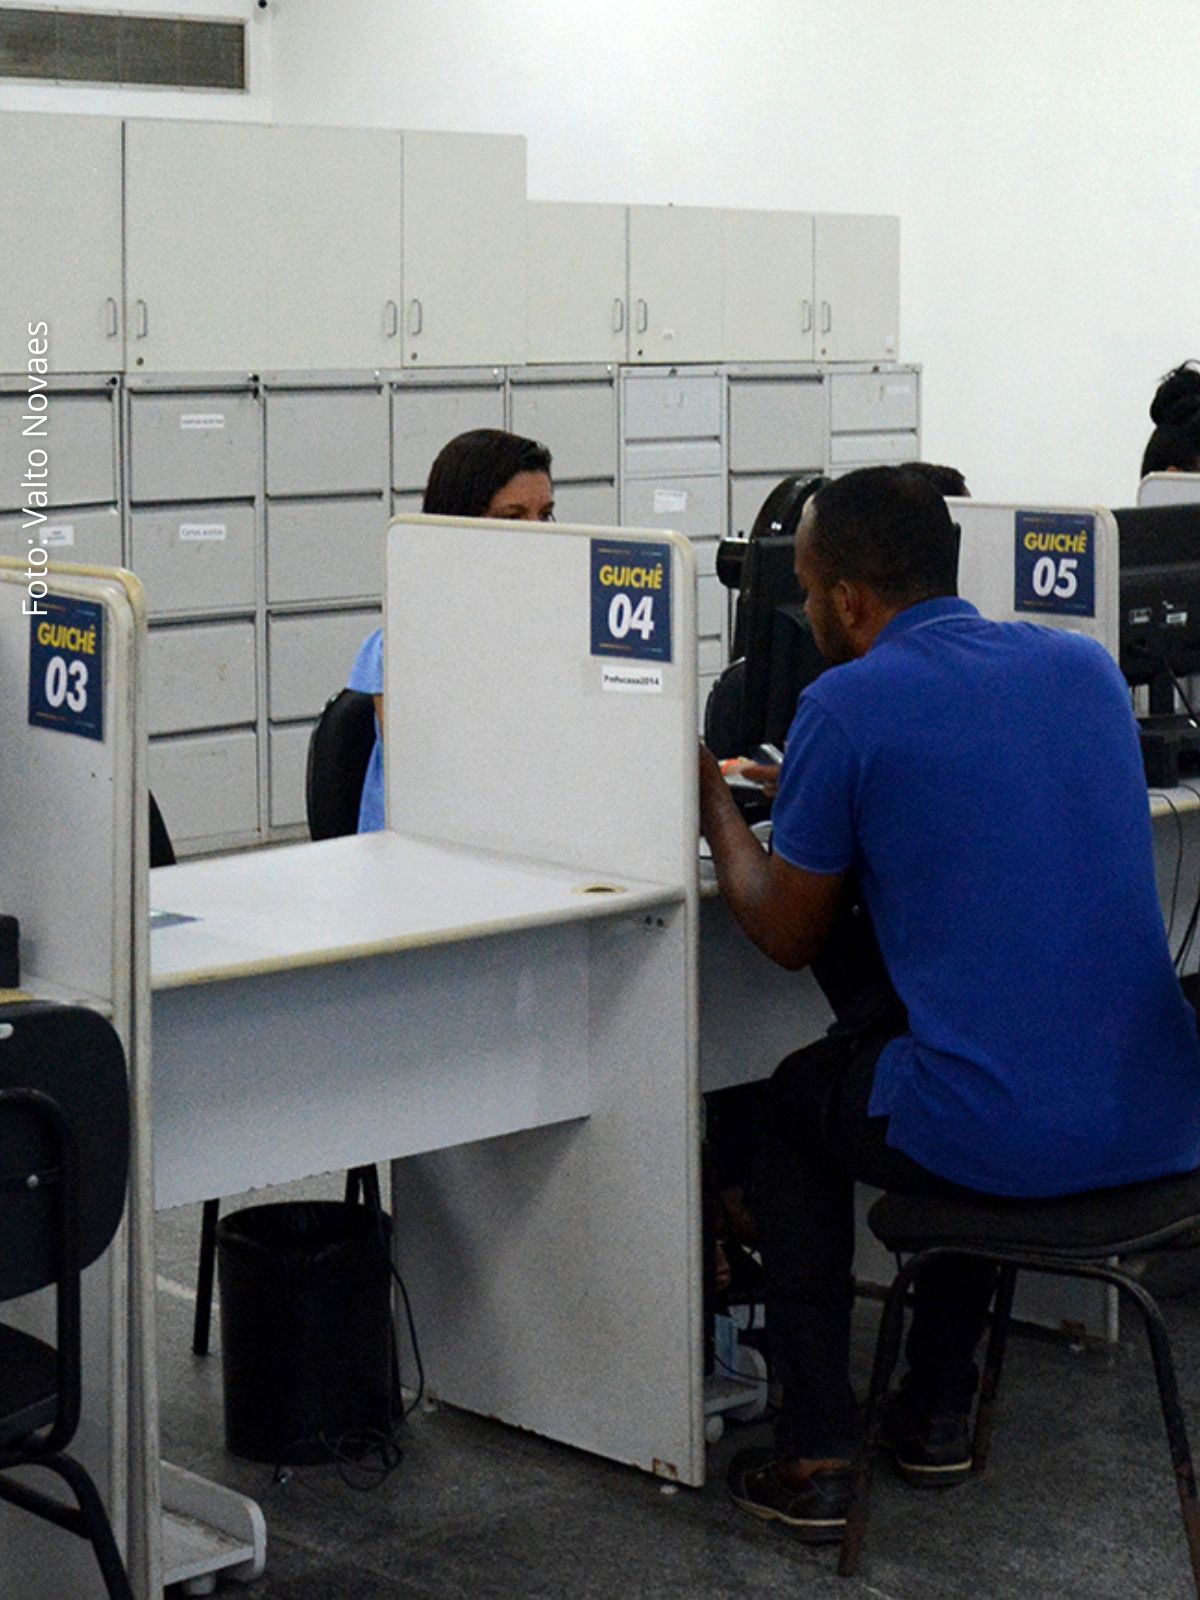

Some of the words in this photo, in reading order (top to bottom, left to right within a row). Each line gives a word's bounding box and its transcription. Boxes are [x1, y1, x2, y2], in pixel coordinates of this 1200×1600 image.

[1024, 530, 1087, 553] GUICHÊ
[599, 563, 663, 590] GUICHÊ
[1033, 556, 1077, 599] 05
[609, 593, 654, 640] 04
[37, 622, 96, 654] GUICHÊ
[45, 656, 89, 712] 03
